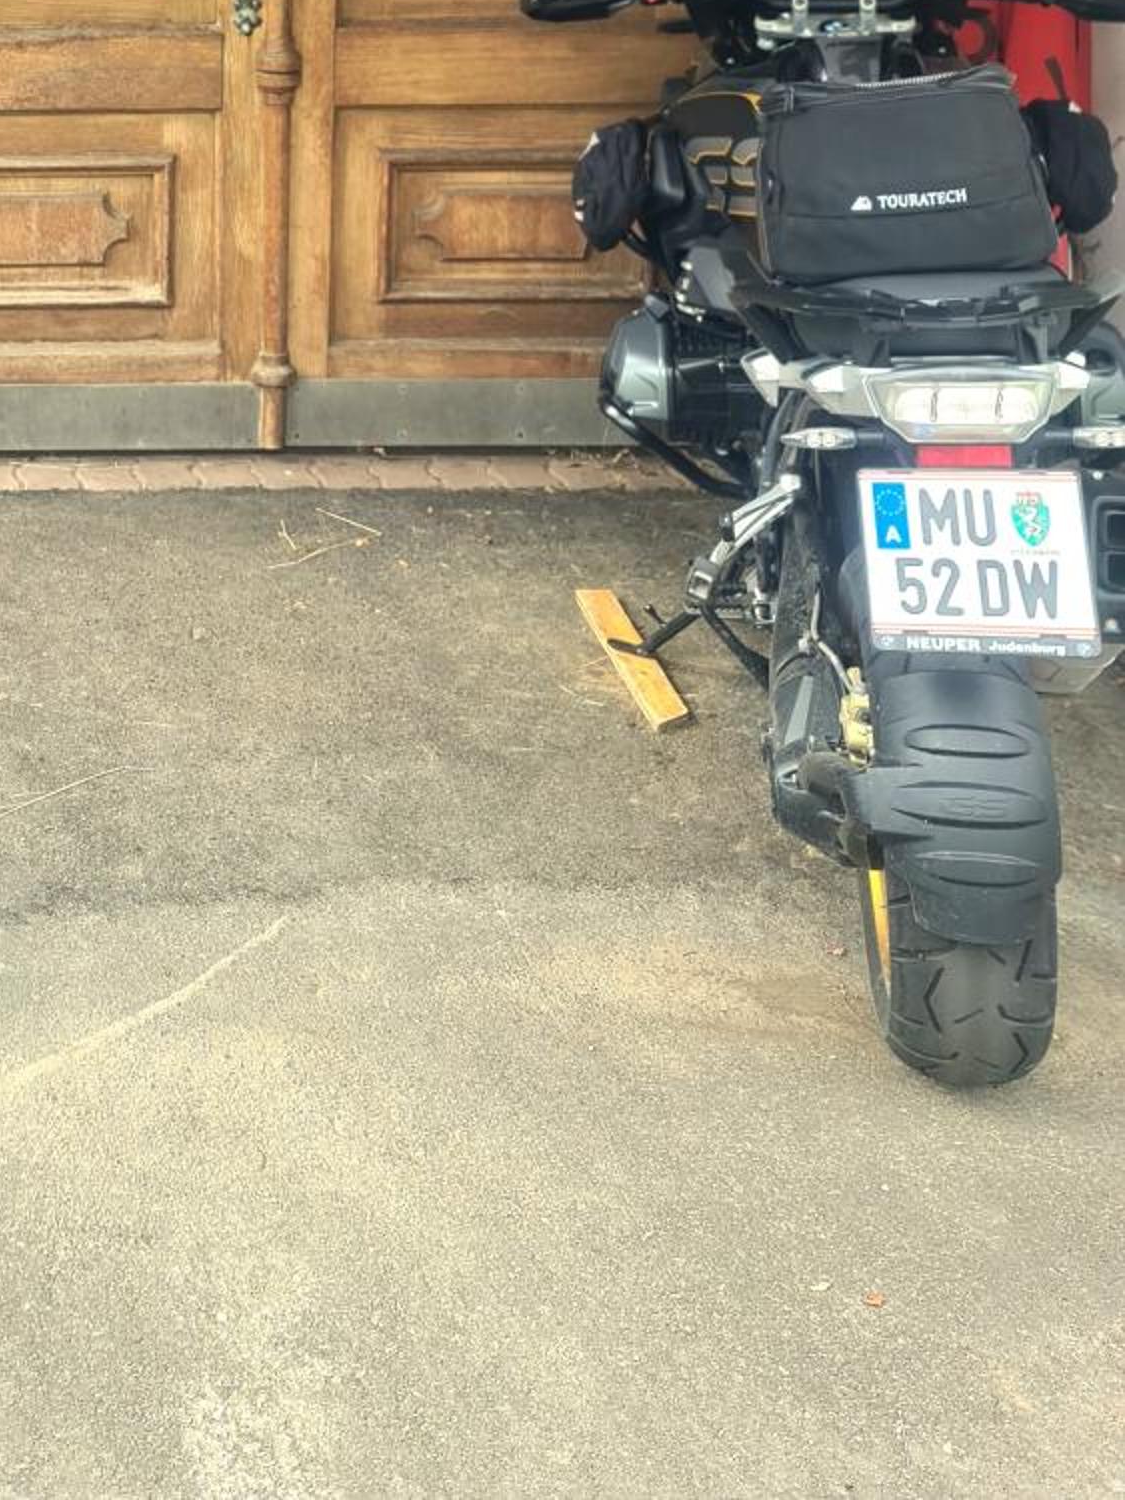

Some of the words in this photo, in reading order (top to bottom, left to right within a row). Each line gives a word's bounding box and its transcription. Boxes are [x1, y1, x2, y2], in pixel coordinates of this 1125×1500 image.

[876, 188, 967, 210] TOURATECH
[918, 487, 997, 547] MU
[885, 525, 902, 543] A
[895, 557, 965, 616] 52
[976, 558, 1058, 619] DW
[906, 636, 981, 652] NEUPER
[988, 641, 1066, 657] Judenburg
